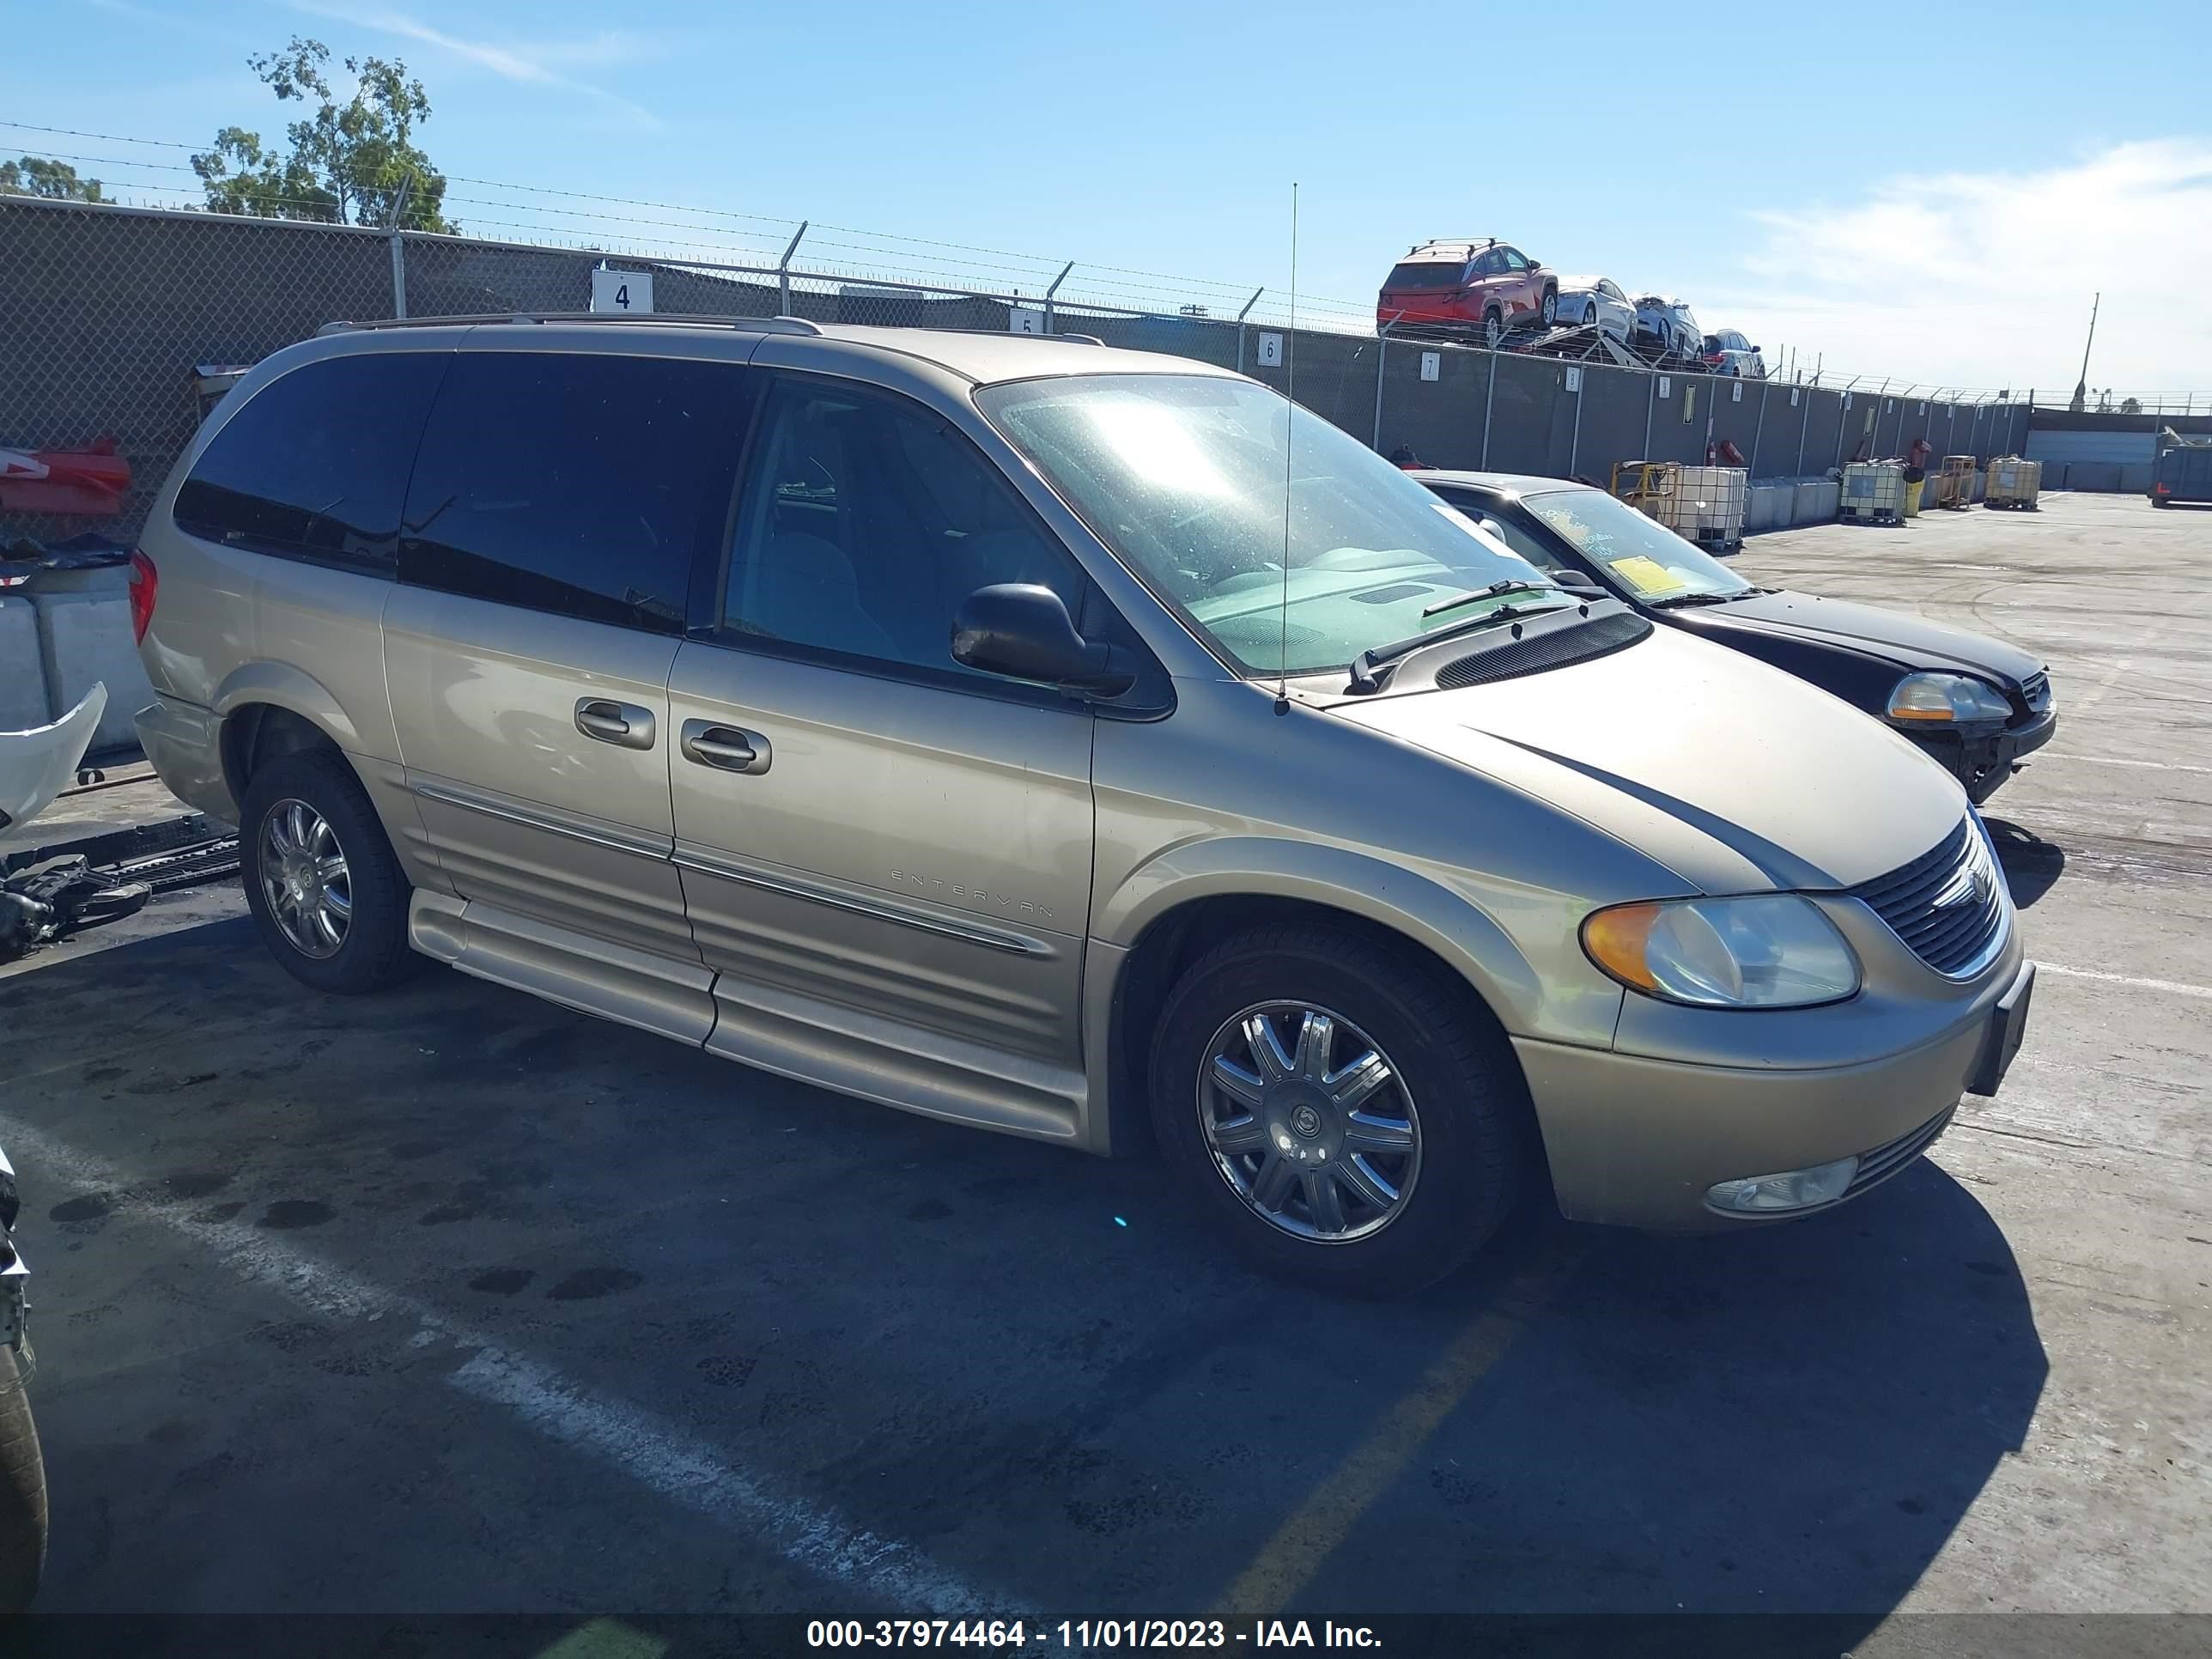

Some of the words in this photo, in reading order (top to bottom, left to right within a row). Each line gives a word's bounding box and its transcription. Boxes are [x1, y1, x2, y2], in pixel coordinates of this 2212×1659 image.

[615, 284, 630, 310] 4
[1023, 319, 1031, 333] 5
[1266, 341, 1274, 359] 6
[1428, 359, 1433, 374] 7
[890, 869, 1054, 918] ENTERVAN
